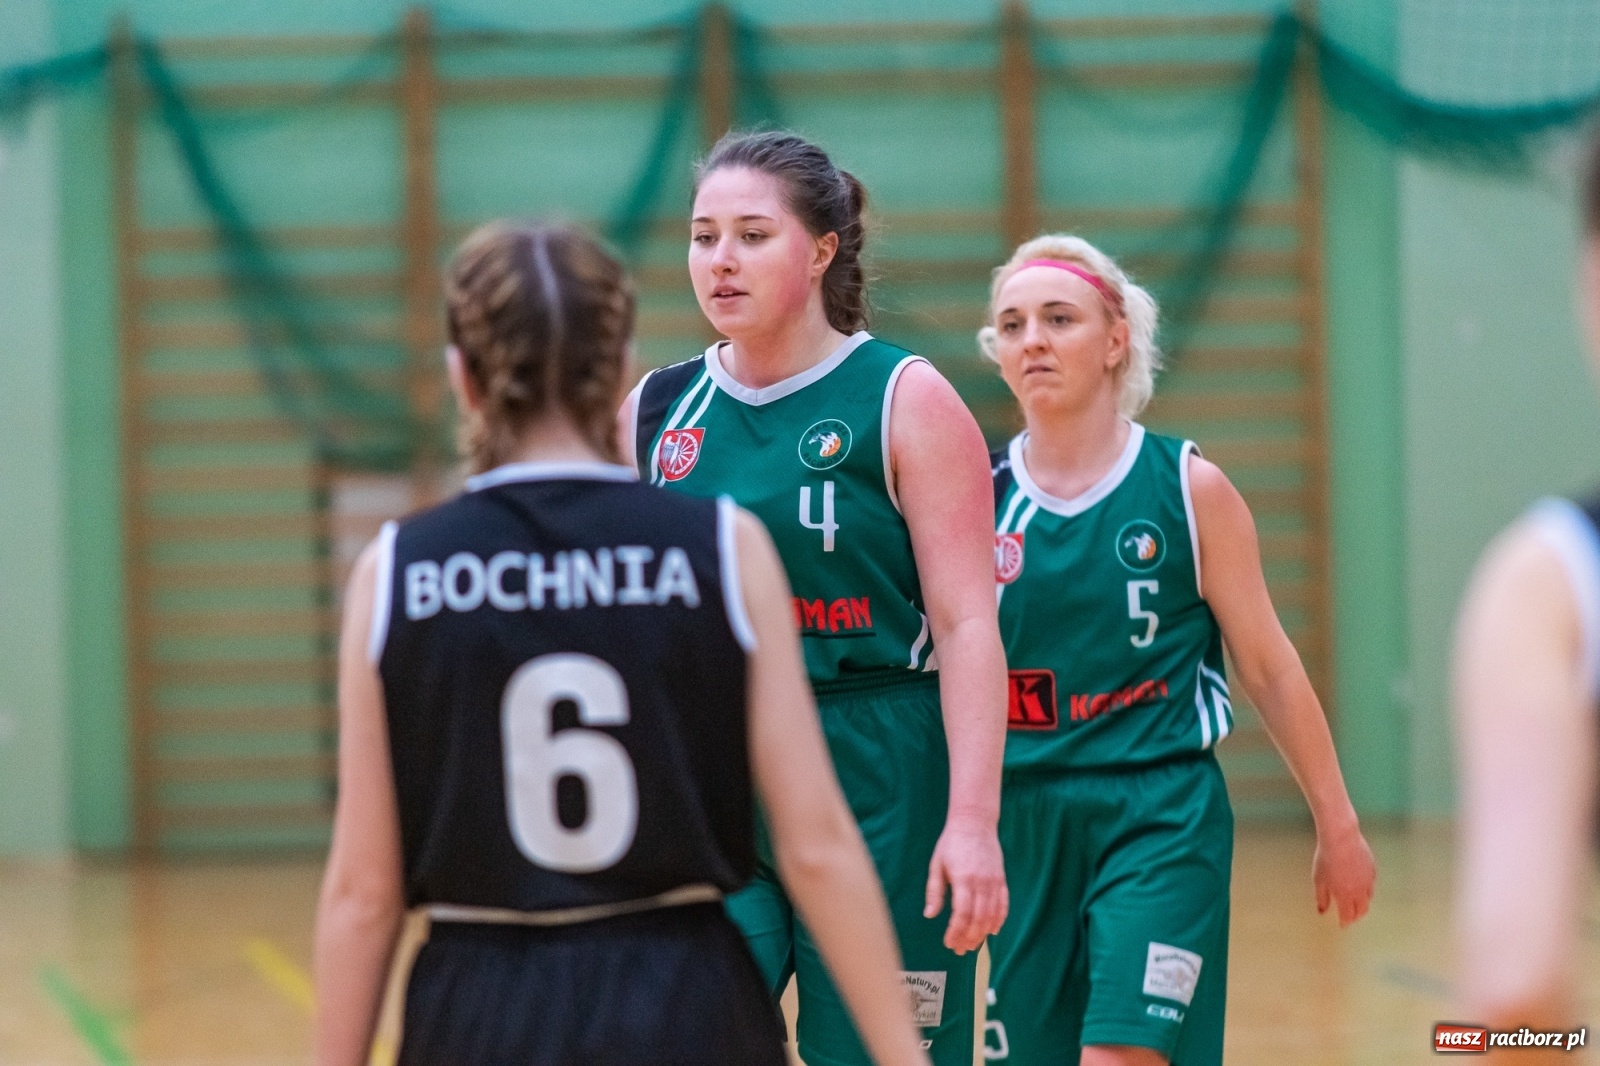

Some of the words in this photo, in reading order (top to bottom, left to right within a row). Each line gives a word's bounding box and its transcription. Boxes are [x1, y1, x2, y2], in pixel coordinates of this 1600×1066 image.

[798, 481, 840, 552] 4
[404, 545, 701, 621] BOCHNIA
[791, 596, 873, 633] MAN
[1126, 579, 1160, 649] 5
[500, 652, 640, 874] 6
